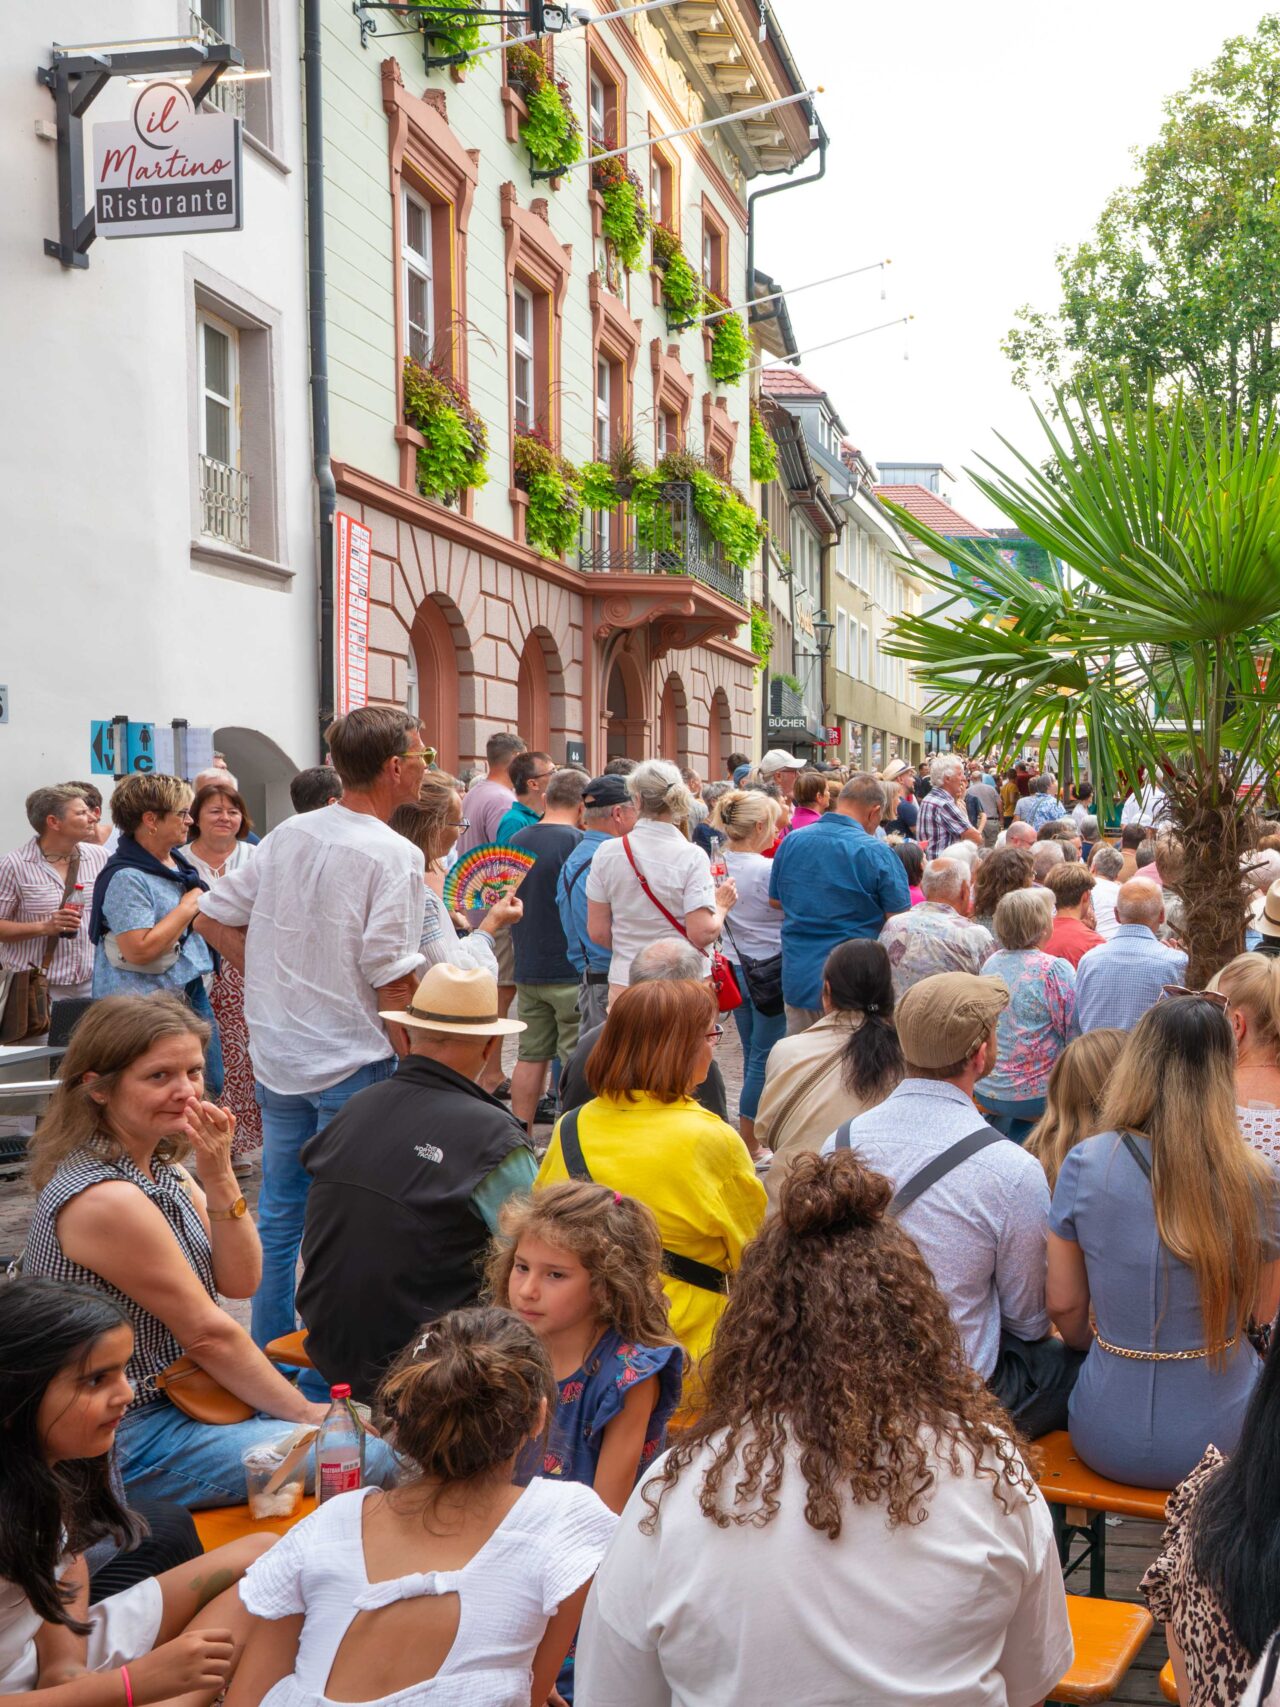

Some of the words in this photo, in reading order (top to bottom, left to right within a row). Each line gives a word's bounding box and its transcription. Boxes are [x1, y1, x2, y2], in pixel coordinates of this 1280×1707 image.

[146, 95, 179, 133] il
[101, 145, 231, 190] Martino
[102, 189, 227, 219] Ristorante
[769, 717, 806, 728] BÜCHER
